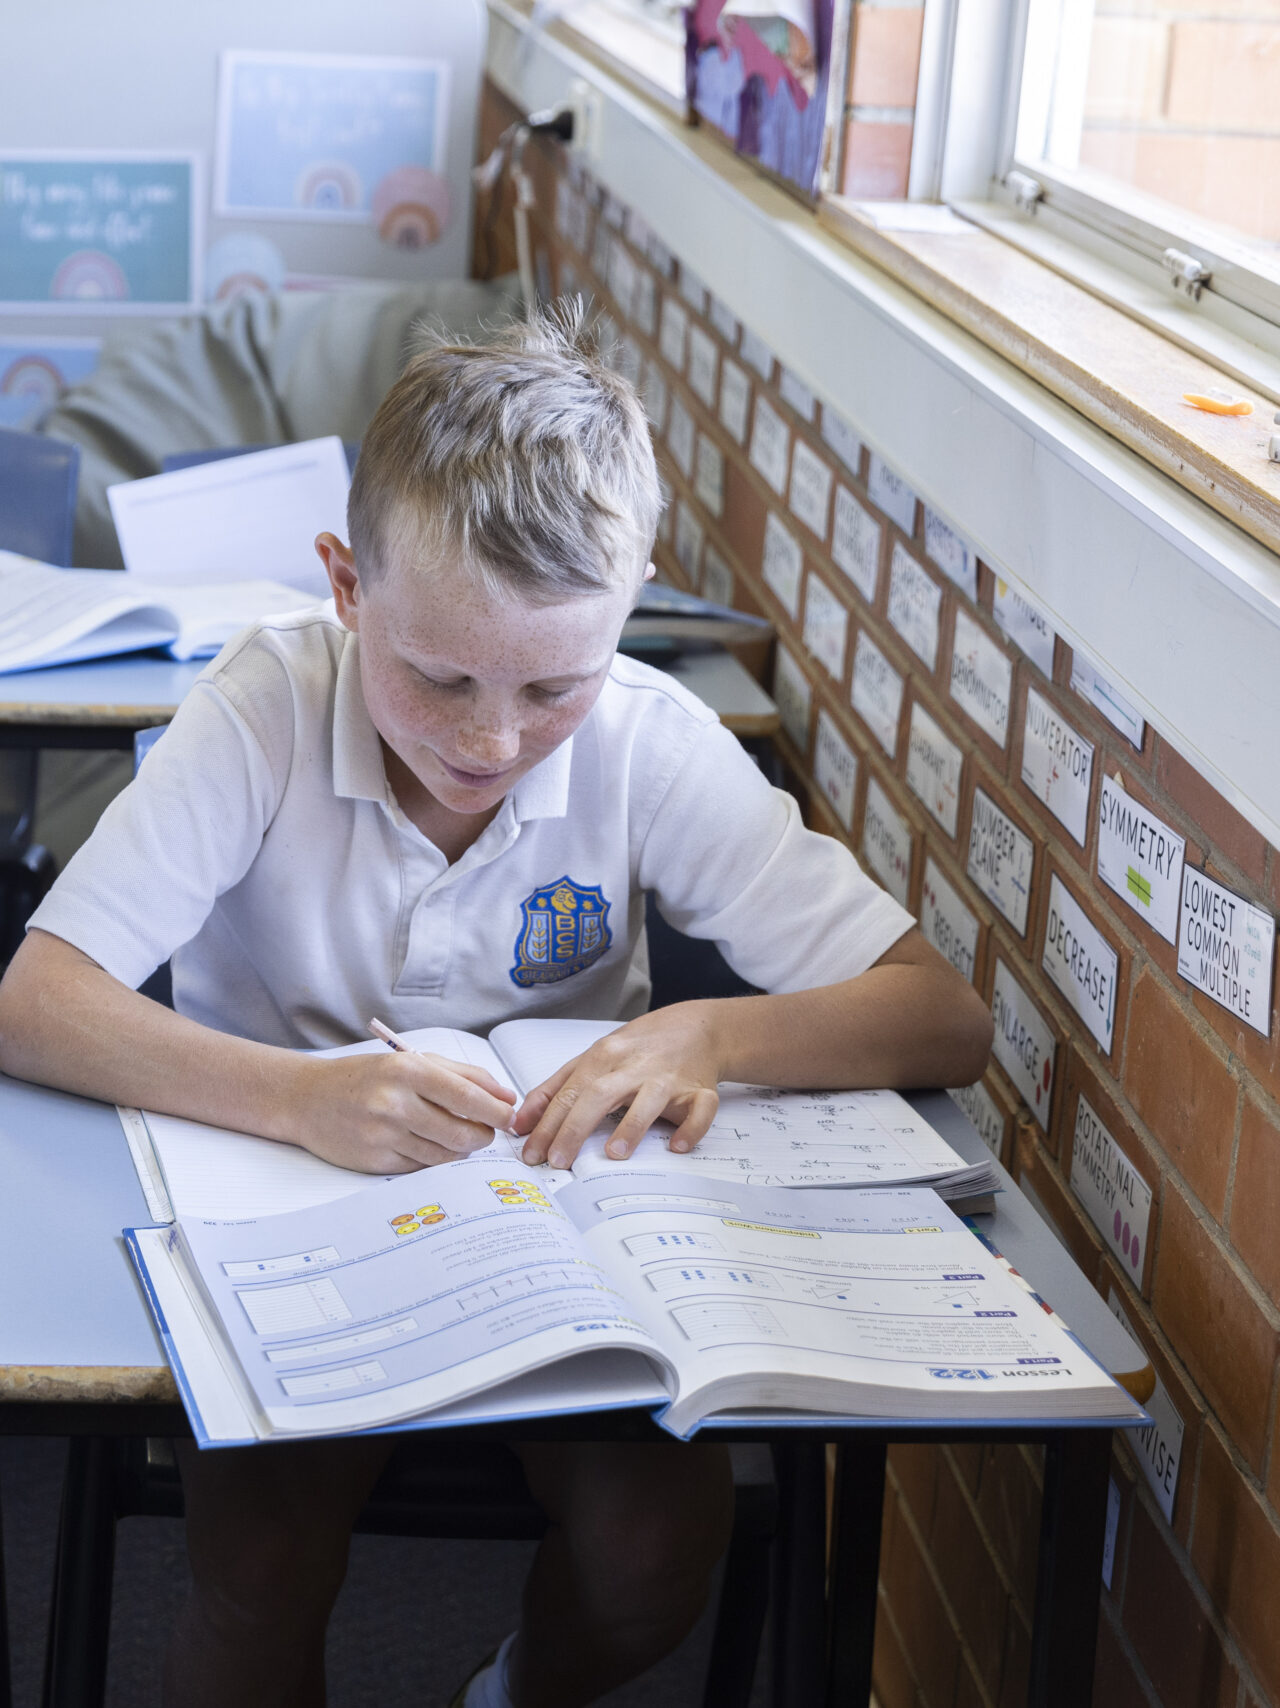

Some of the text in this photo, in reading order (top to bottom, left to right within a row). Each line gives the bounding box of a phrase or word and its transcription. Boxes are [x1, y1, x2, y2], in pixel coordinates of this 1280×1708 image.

[950, 647, 1007, 731] DENOMINATOR
[1026, 700, 1090, 787] NUMERATOR
[970, 830, 1002, 889] PLANE
[972, 790, 1016, 866] NUMBER
[1100, 789, 1177, 881] SYMMETRY
[555, 914, 576, 959] BCS
[1184, 874, 1236, 937] LOWEST
[933, 908, 974, 986] REFLECT
[1048, 908, 1108, 1012] DECREASE
[1186, 917, 1240, 979] COMMON
[1199, 957, 1251, 1018] MULTIPLE
[993, 988, 1040, 1082] ENLARGE
[1073, 1133, 1117, 1210] SYMMETRY
[1077, 1103, 1134, 1209] ROTATINAL
[925, 1367, 1073, 1381] Lesson 122
[1136, 1424, 1175, 1495] WISE
